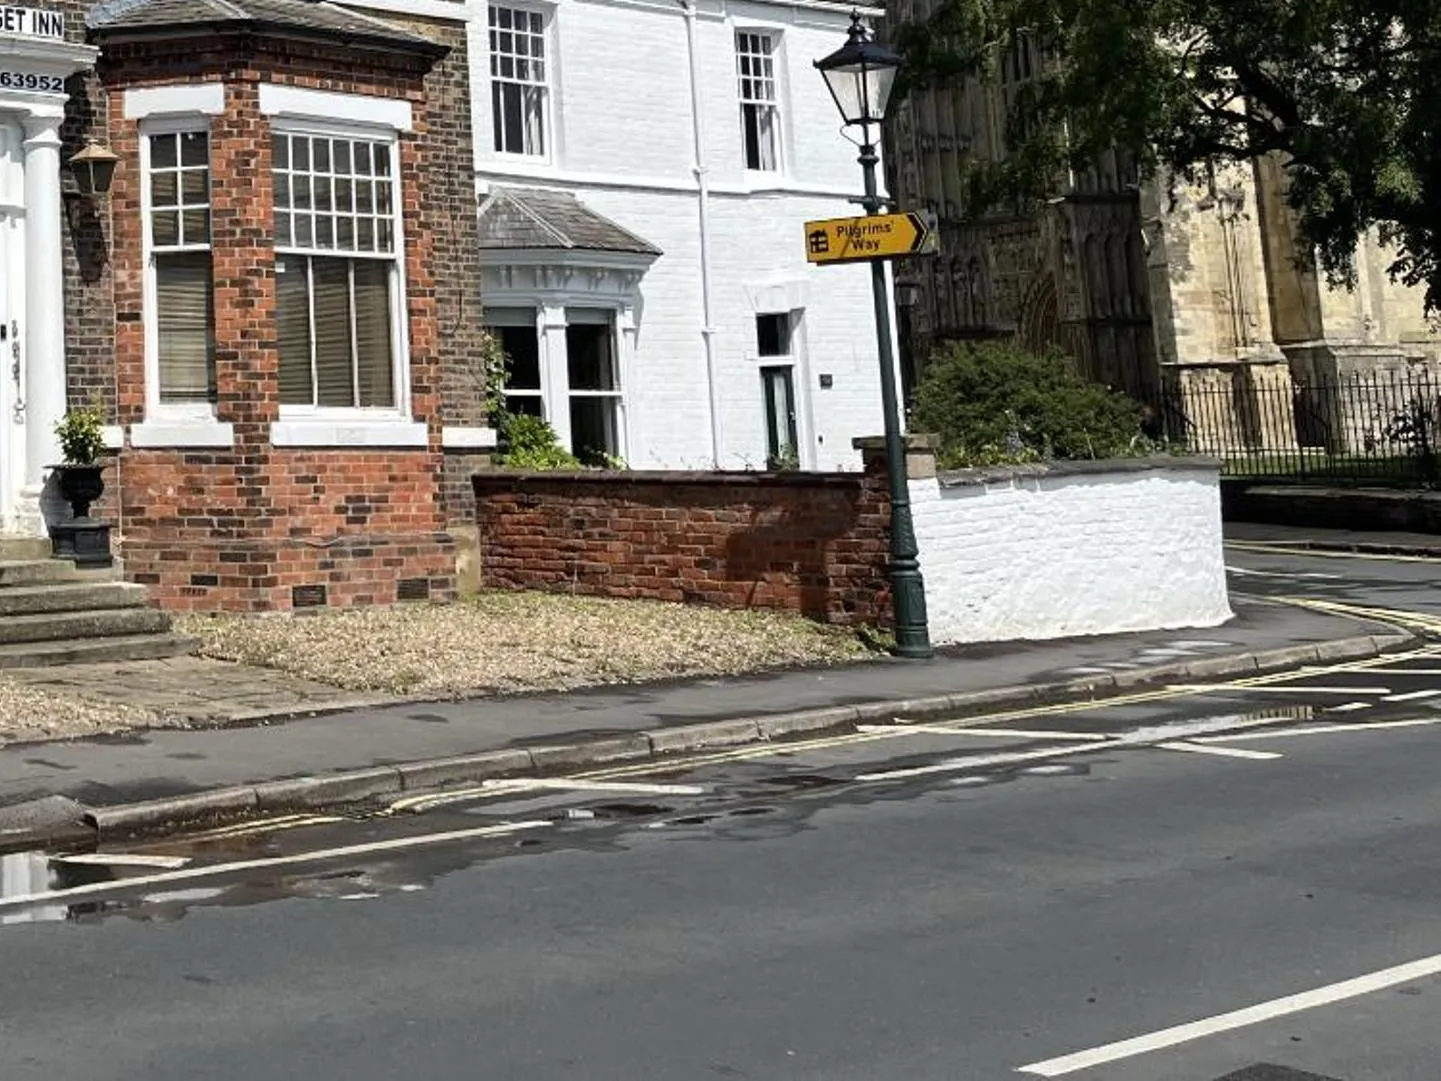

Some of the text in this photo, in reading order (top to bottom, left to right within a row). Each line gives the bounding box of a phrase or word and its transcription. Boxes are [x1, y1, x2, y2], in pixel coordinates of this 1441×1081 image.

[33, 10, 63, 37] INN
[836, 221, 894, 238] Pilgrims'
[851, 238, 881, 251] Way
